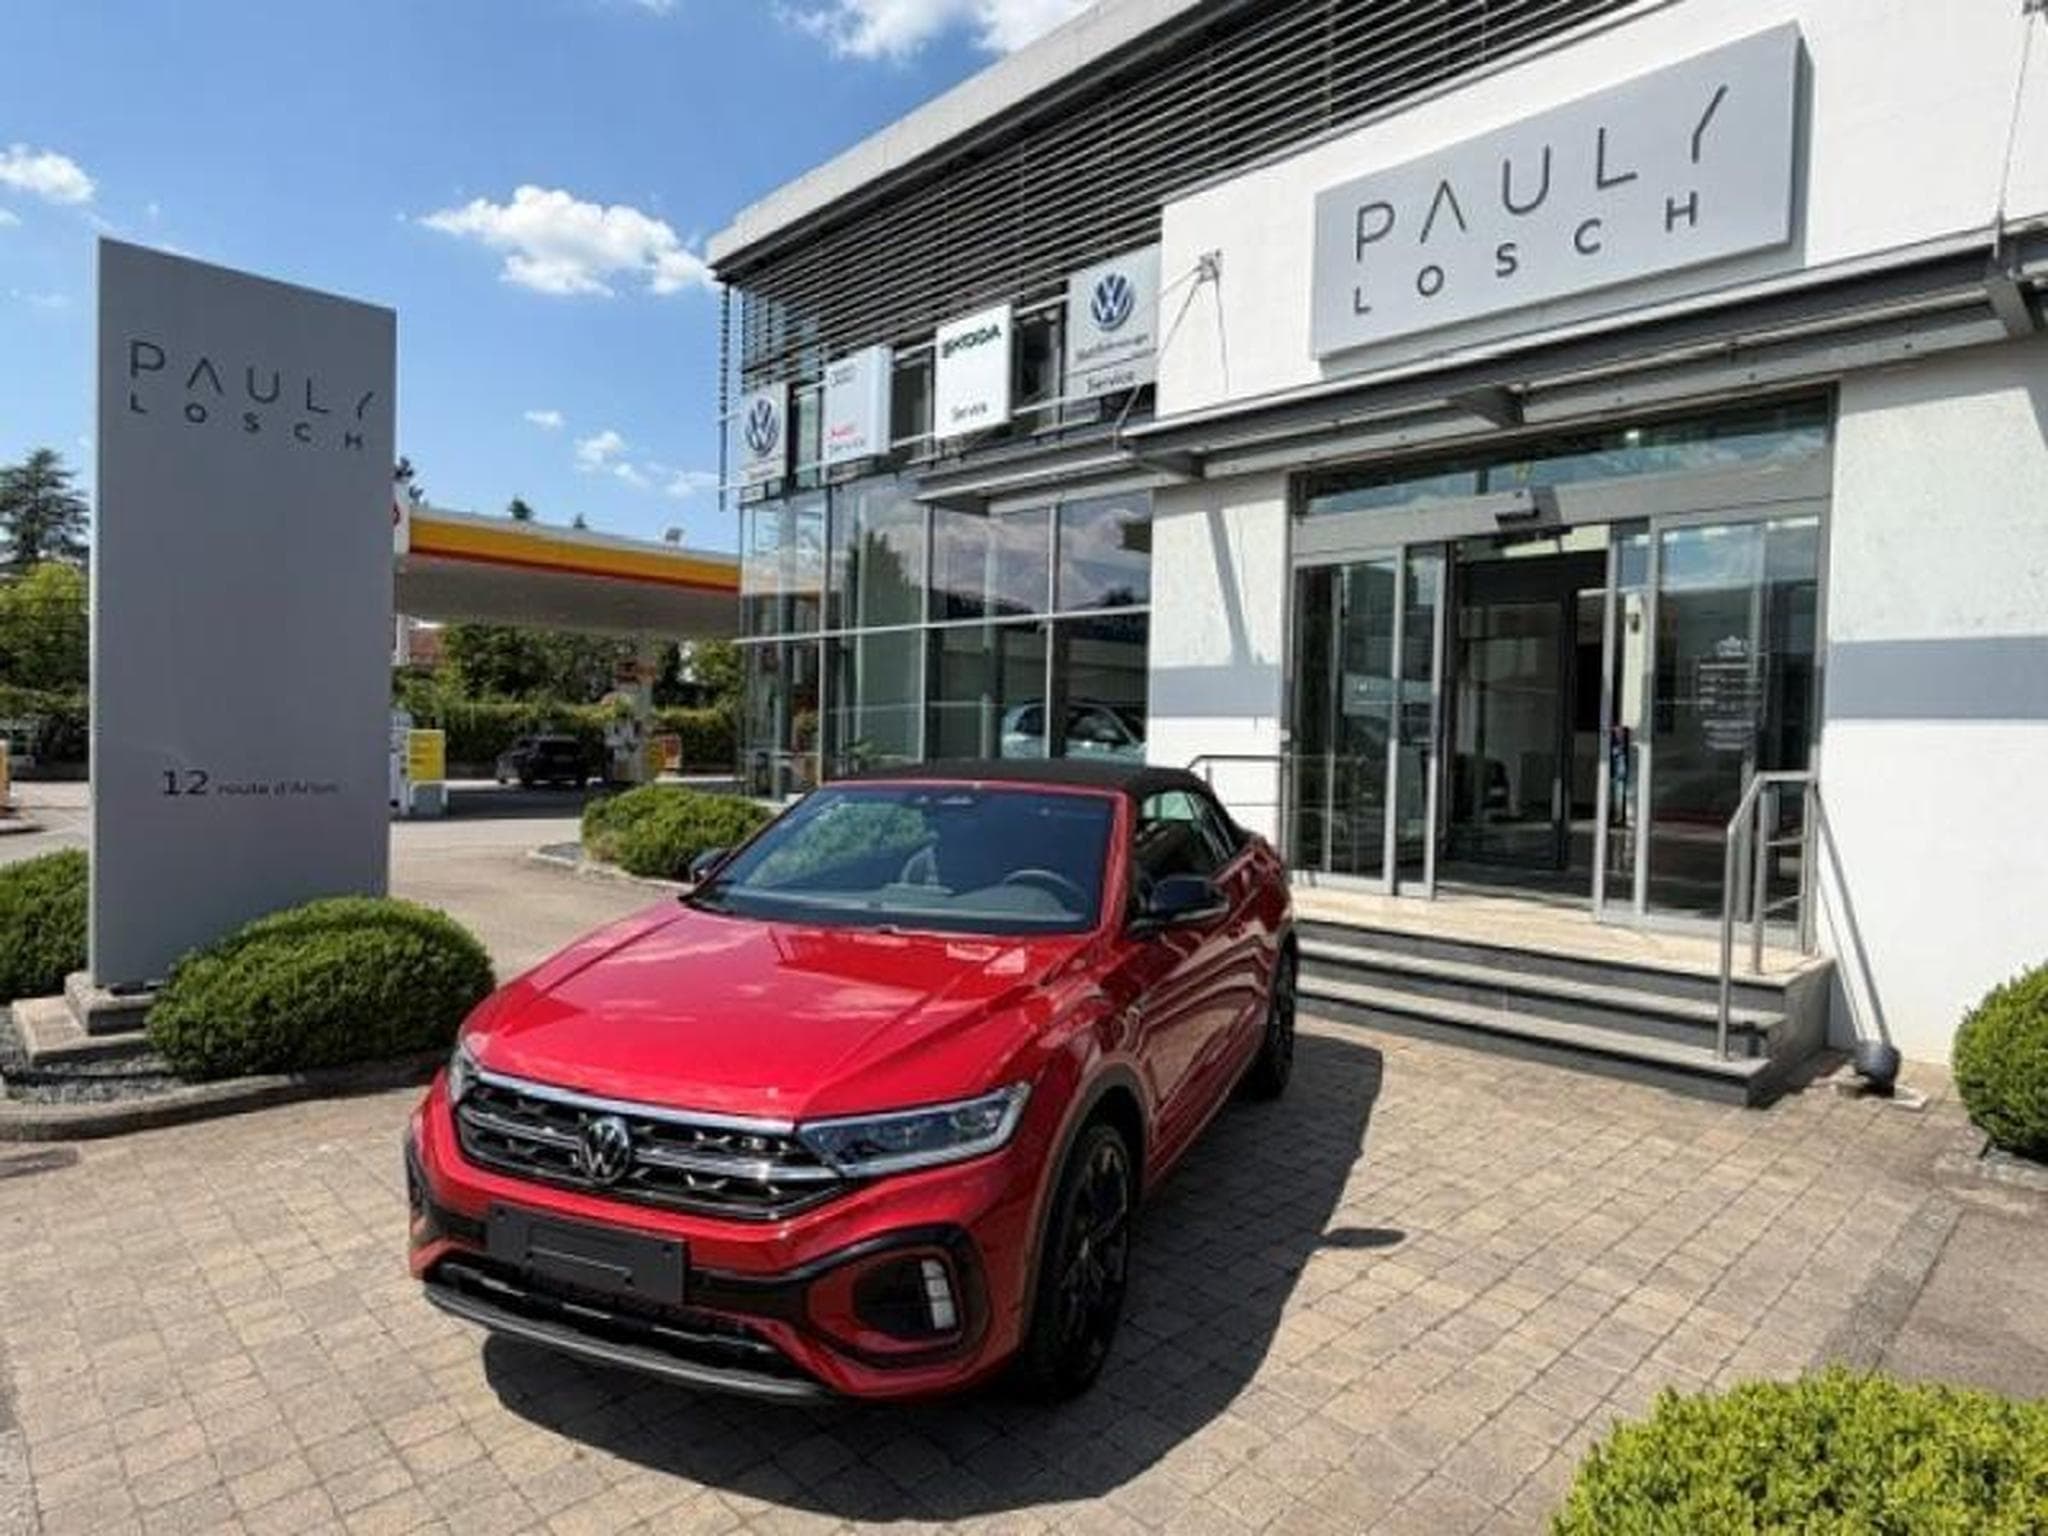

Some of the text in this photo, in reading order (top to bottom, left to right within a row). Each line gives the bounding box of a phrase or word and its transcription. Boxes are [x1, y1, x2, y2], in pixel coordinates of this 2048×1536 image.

[1355, 85, 1729, 263] PAULY
[1354, 191, 1699, 316] LOSCH
[129, 339, 375, 420] PAULY
[129, 393, 363, 450] LOSCH
[162, 769, 209, 797] 12
